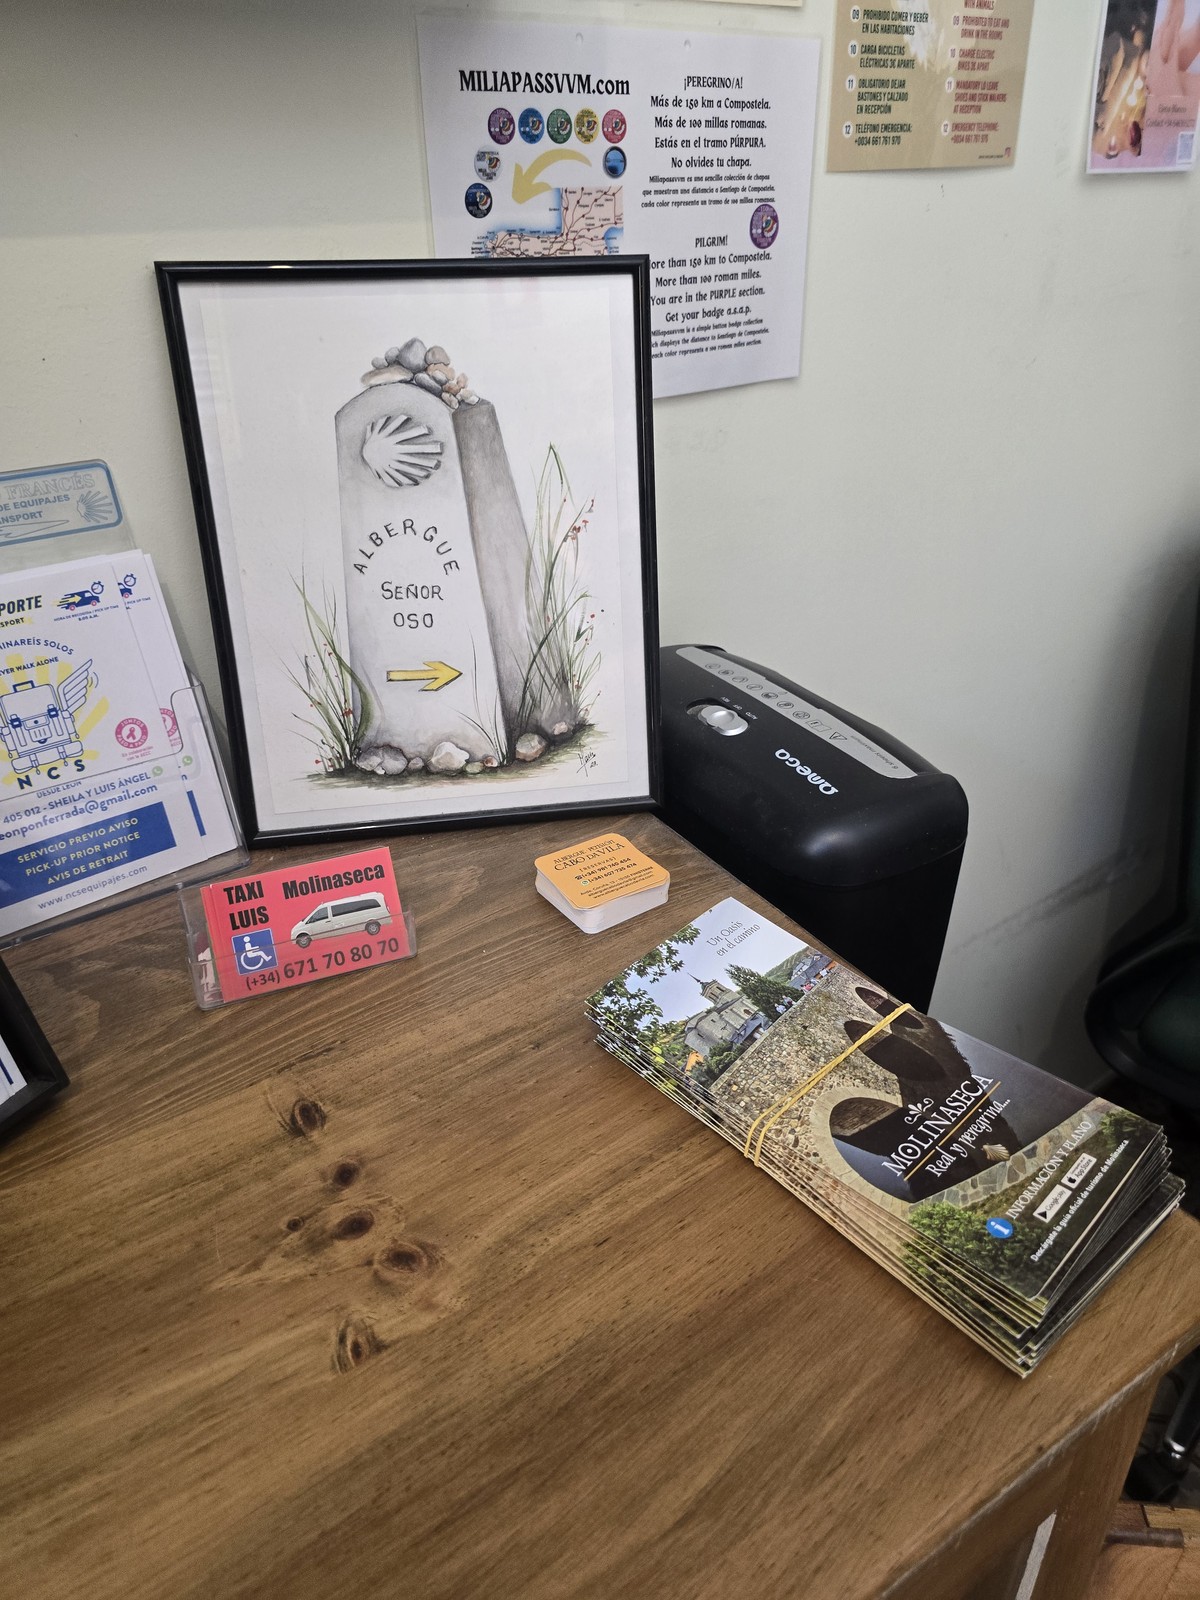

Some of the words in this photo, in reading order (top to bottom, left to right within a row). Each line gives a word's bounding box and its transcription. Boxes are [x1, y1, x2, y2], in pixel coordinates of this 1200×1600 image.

[852, 10, 860, 20] 09
[863, 10, 890, 20] PROHIBIDO
[891, 11, 908, 22] COMER
[862, 23, 869, 34] EN
[870, 24, 880, 34] LAS
[880, 24, 915, 36] HABITACIONES
[850, 44, 856, 54] 10
[860, 44, 877, 54] CARGA
[878, 45, 906, 56] BICICLETAS
[860, 57, 888, 68] ELÉCTRICAS
[897, 59, 916, 69] APARTE
[459, 70, 630, 95] MILIAPASSVVM.com
[684, 76, 743, 90] ¡PEREGRINO/A!
[848, 79, 854, 89] 11
[858, 79, 890, 88] OBLIGATORIO
[891, 80, 906, 89] DEJAR
[650, 95, 669, 107] Más
[672, 96, 682, 108] de
[686, 99, 698, 110] 150
[702, 96, 714, 108] km
[716, 100, 722, 108] a
[724, 98, 771, 112] Compostela.
[857, 92, 882, 102] BASTONES
[887, 92, 908, 102] CALZADO
[856, 104, 863, 114] EN
[864, 103, 892, 114] RECEPCIÓN
[654, 116, 673, 128] Más
[676, 116, 686, 128] de
[690, 119, 702, 128] 100
[705, 116, 728, 128] millas
[731, 120, 767, 128] romanas.
[845, 125, 851, 134] 12
[856, 122, 880, 133] TELÉFONO
[880, 123, 912, 134] EMERGENCIA:
[654, 136, 678, 148] Estás
[681, 139, 690, 148] en
[694, 137, 700, 148] el
[704, 138, 728, 148] tramo
[730, 134, 766, 148] PÚRPURA.
[854, 136, 870, 146] +0034
[872, 136, 881, 146] 661
[882, 136, 890, 145] 761
[892, 136, 901, 145] 970
[671, 157, 682, 168] No
[686, 156, 714, 168] olvides
[716, 158, 724, 168] tu
[727, 156, 752, 169] chapa.
[695, 235, 728, 248] PILGRIM!
[650, 260, 665, 269] ore
[668, 258, 686, 268] than
[690, 258, 702, 268] 150
[704, 255, 716, 266] km
[718, 255, 726, 264] to
[728, 250, 772, 265] Compostela.
[656, 277, 676, 287] More
[680, 275, 698, 286] than
[700, 276, 712, 284] 100
[714, 273, 738, 282] roman
[741, 269, 762, 280] miles.
[650, 296, 666, 306] You
[668, 295, 682, 304] are
[685, 292, 692, 302] in
[696, 291, 708, 301] the
[710, 288, 736, 300] PURPLE
[738, 286, 766, 298] section.
[665, 312, 678, 322] Get
[682, 310, 699, 323] your
[702, 307, 724, 319] badge
[726, 305, 752, 318] a.s.a.p.
[4, 472, 96, 500] FRANCÉS
[14, 494, 70, 508] EQUIPAJES
[354, 518, 460, 576] ALBERGUE
[381, 580, 444, 600] SEÑOR
[393, 612, 434, 629] OSO
[44, 638, 74, 656] SOLOS
[16, 662, 36, 672] WALK
[36, 656, 59, 666] ALONE
[3, 813, 23, 824] 405
[24, 806, 42, 818] 012
[48, 794, 86, 810] SHEILA
[86, 790, 92, 798] Y
[95, 784, 116, 795] LUIS
[118, 772, 152, 788] ÁNGEL
[18, 841, 66, 864] SERVICIO
[69, 828, 106, 846] PREVIO
[108, 817, 138, 833] AVISO
[26, 856, 68, 876] PICK-UP
[70, 845, 101, 860] PRIOR
[103, 831, 140, 850] NOTICE
[554, 856, 586, 870] CABO
[600, 842, 626, 854] VILA
[48, 870, 71, 884] AVIS
[73, 865, 87, 876] DE
[89, 850, 128, 870] RETRAIT
[38, 865, 148, 910] www.ncsequipajes.com
[223, 880, 264, 905] TAXI
[282, 864, 386, 900] Molinaseca
[229, 906, 270, 931] LUIS
[706, 935, 724, 946] Un
[721, 920, 744, 938] Oasis
[716, 946, 728, 957] en
[726, 940, 736, 950] el
[733, 924, 761, 946] camino
[246, 970, 281, 991] (+34)
[283, 958, 318, 980] 671
[322, 950, 346, 970] 70
[350, 943, 373, 962] 80
[376, 937, 400, 956] 70
[882, 1074, 994, 1176] MOLINASECA
[958, 1099, 1011, 1149] peregrina...
[1062, 1120, 1093, 1151] PLANO
[950, 1142, 968, 1158] y
[1057, 1148, 1069, 1157] Y
[1104, 1140, 1129, 1170] Molinaseca
[925, 1145, 957, 1178] Real
[1101, 1165, 1108, 1173] de
[1086, 1172, 1104, 1196] turismo
[1080, 1190, 1088, 1200] de
[1068, 1198, 1083, 1215] oficial
[1055, 1224, 1062, 1232] la
[1030, 1230, 1058, 1262] Descárgate
